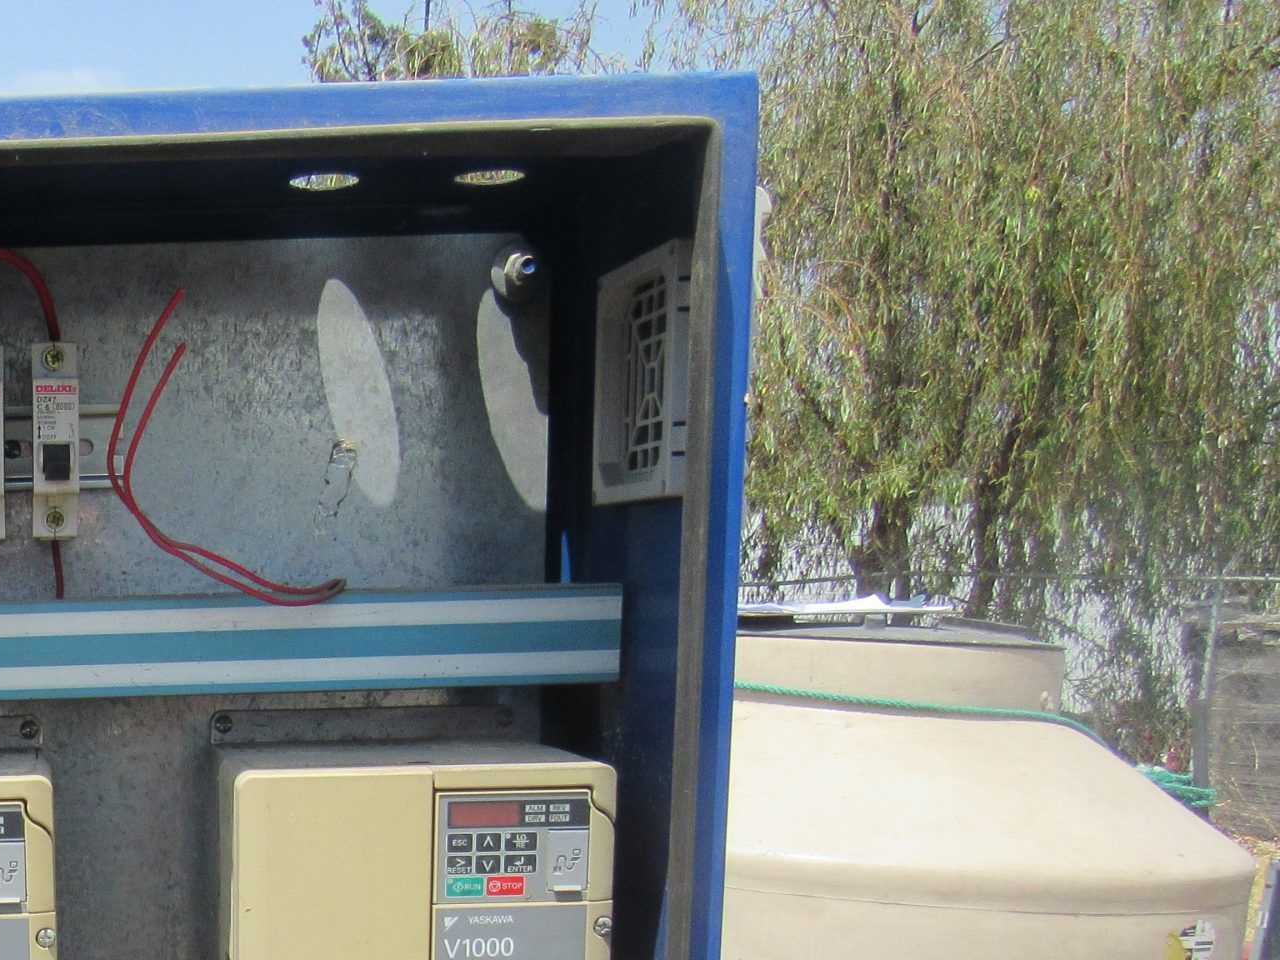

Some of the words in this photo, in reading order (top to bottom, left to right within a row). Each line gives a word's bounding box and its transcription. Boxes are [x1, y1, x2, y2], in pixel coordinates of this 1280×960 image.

[36, 385, 72, 393] DELIXI
[507, 865, 533, 873] ENTER
[468, 915, 513, 924] YASKAWA
[444, 937, 514, 958] V1000
